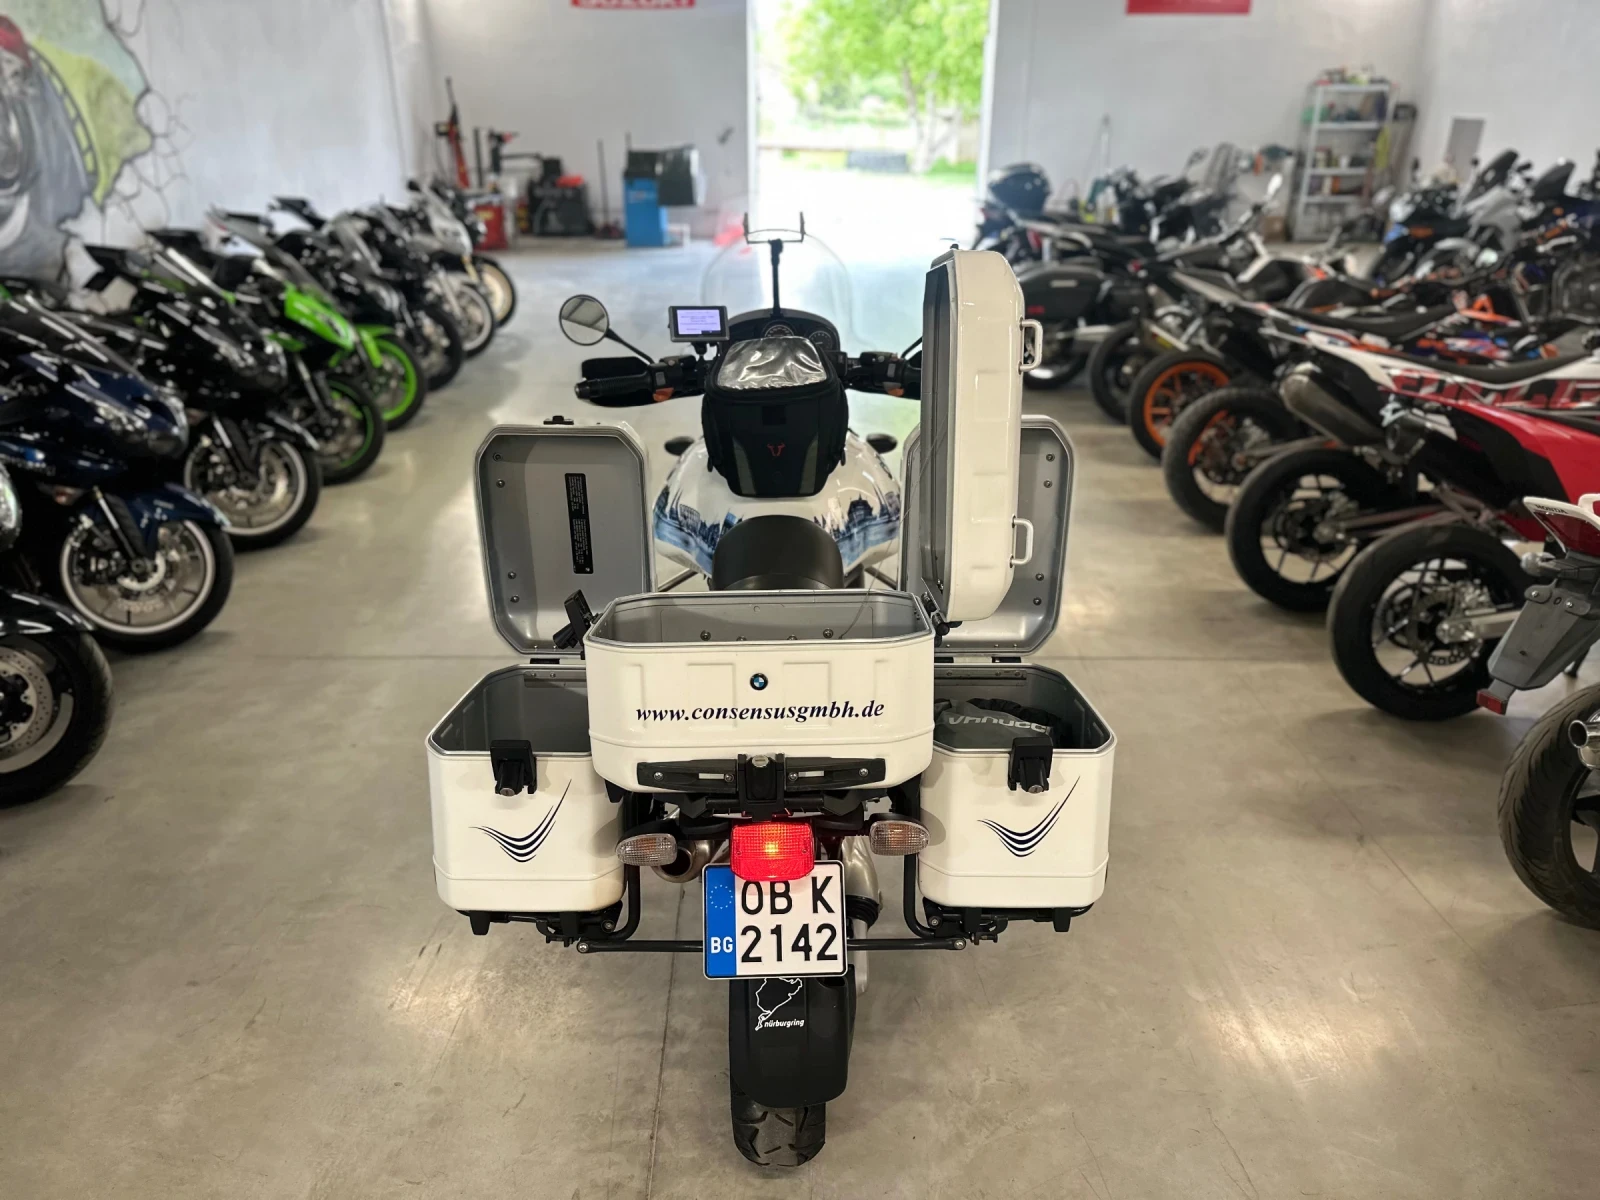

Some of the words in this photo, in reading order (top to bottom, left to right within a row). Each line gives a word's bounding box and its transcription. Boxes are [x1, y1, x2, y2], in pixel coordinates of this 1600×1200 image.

[636, 699, 885, 723] www.consensusgmbh.de
[741, 880, 793, 915] OB
[811, 875, 835, 914] K
[710, 936, 734, 954] BG
[740, 923, 838, 963] 2142
